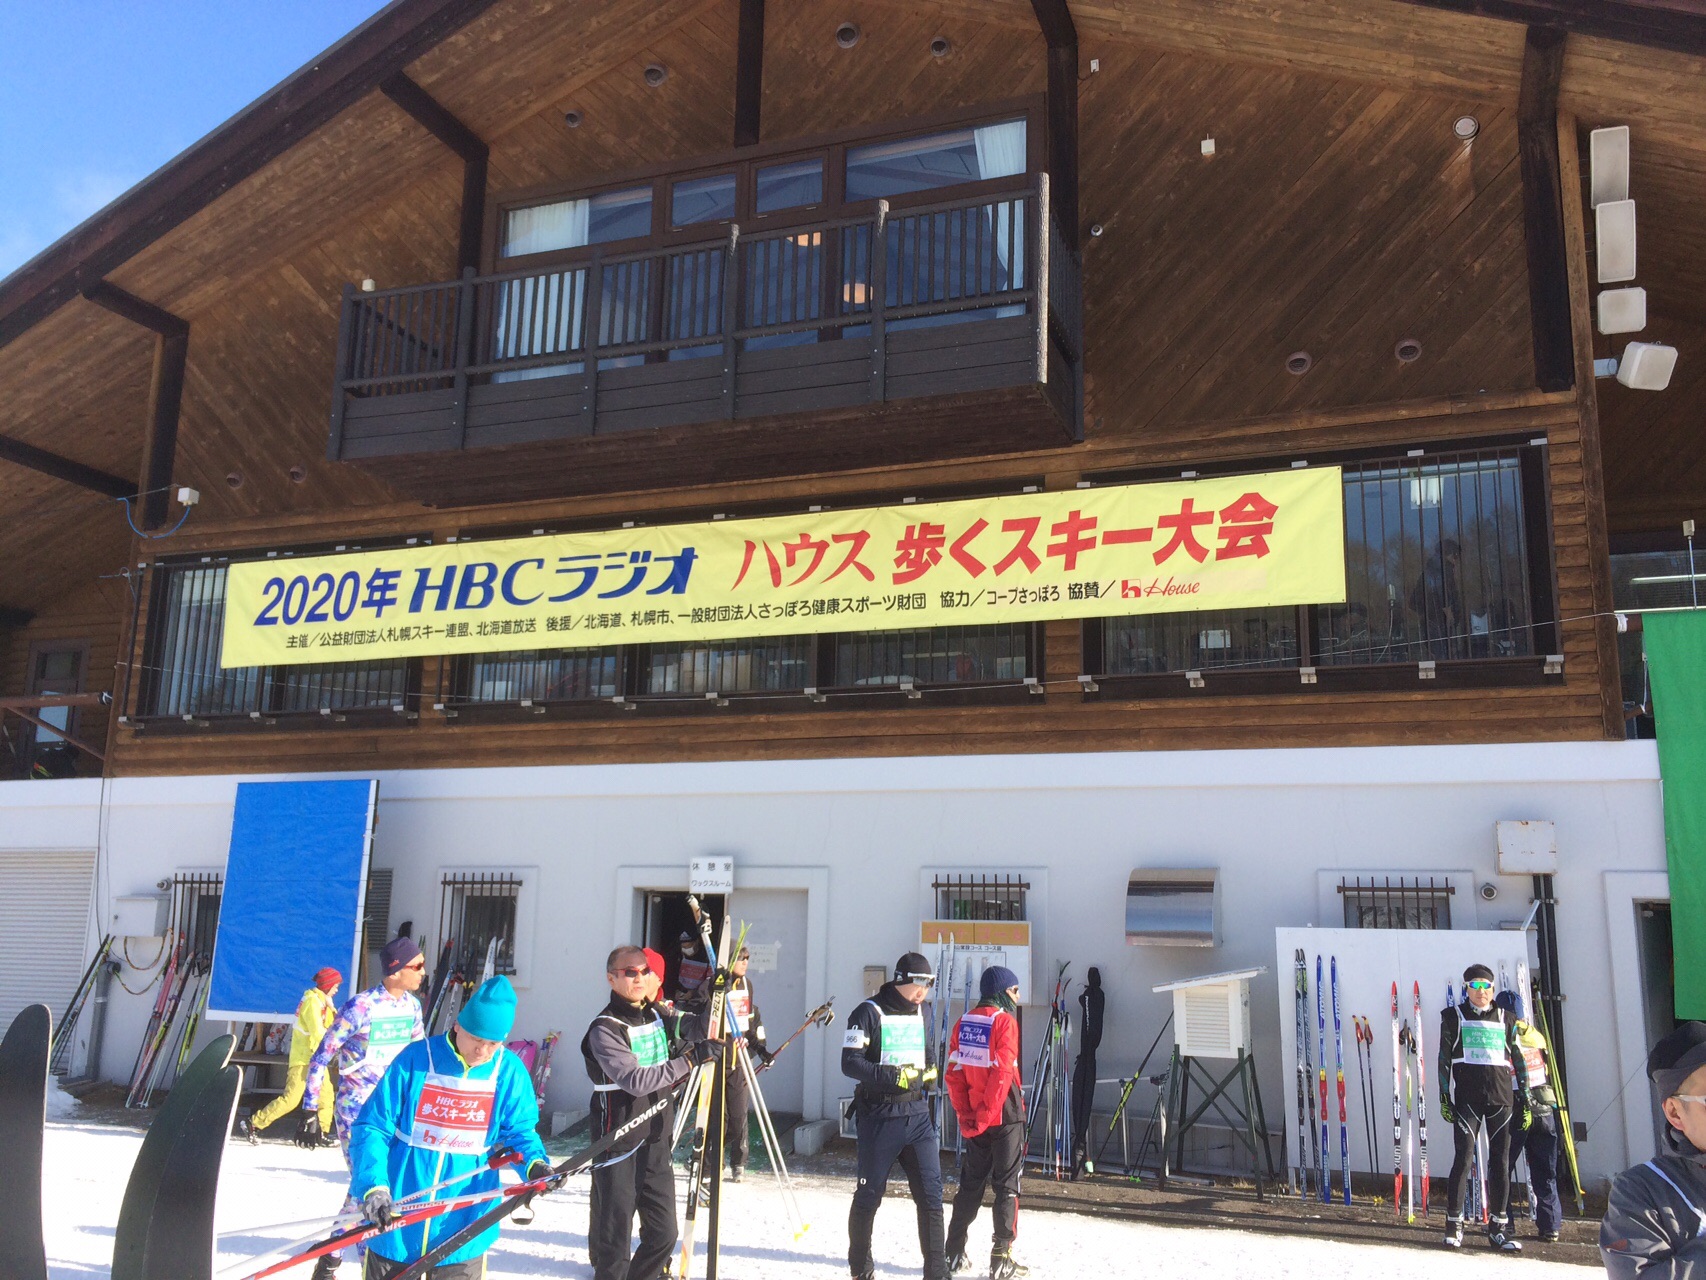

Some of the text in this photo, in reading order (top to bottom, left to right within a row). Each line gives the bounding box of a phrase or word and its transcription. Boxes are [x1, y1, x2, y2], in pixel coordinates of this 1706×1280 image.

[730, 529, 875, 592] ハウス
[892, 492, 1279, 585] 歩くスキー大会
[1143, 576, 1201, 597] House
[422, 1103, 487, 1122] 歩くスキー大会
[436, 1096, 479, 1109] HBCラジオ
[614, 1098, 668, 1141] ATOMIC
[437, 1134, 474, 1147] House
